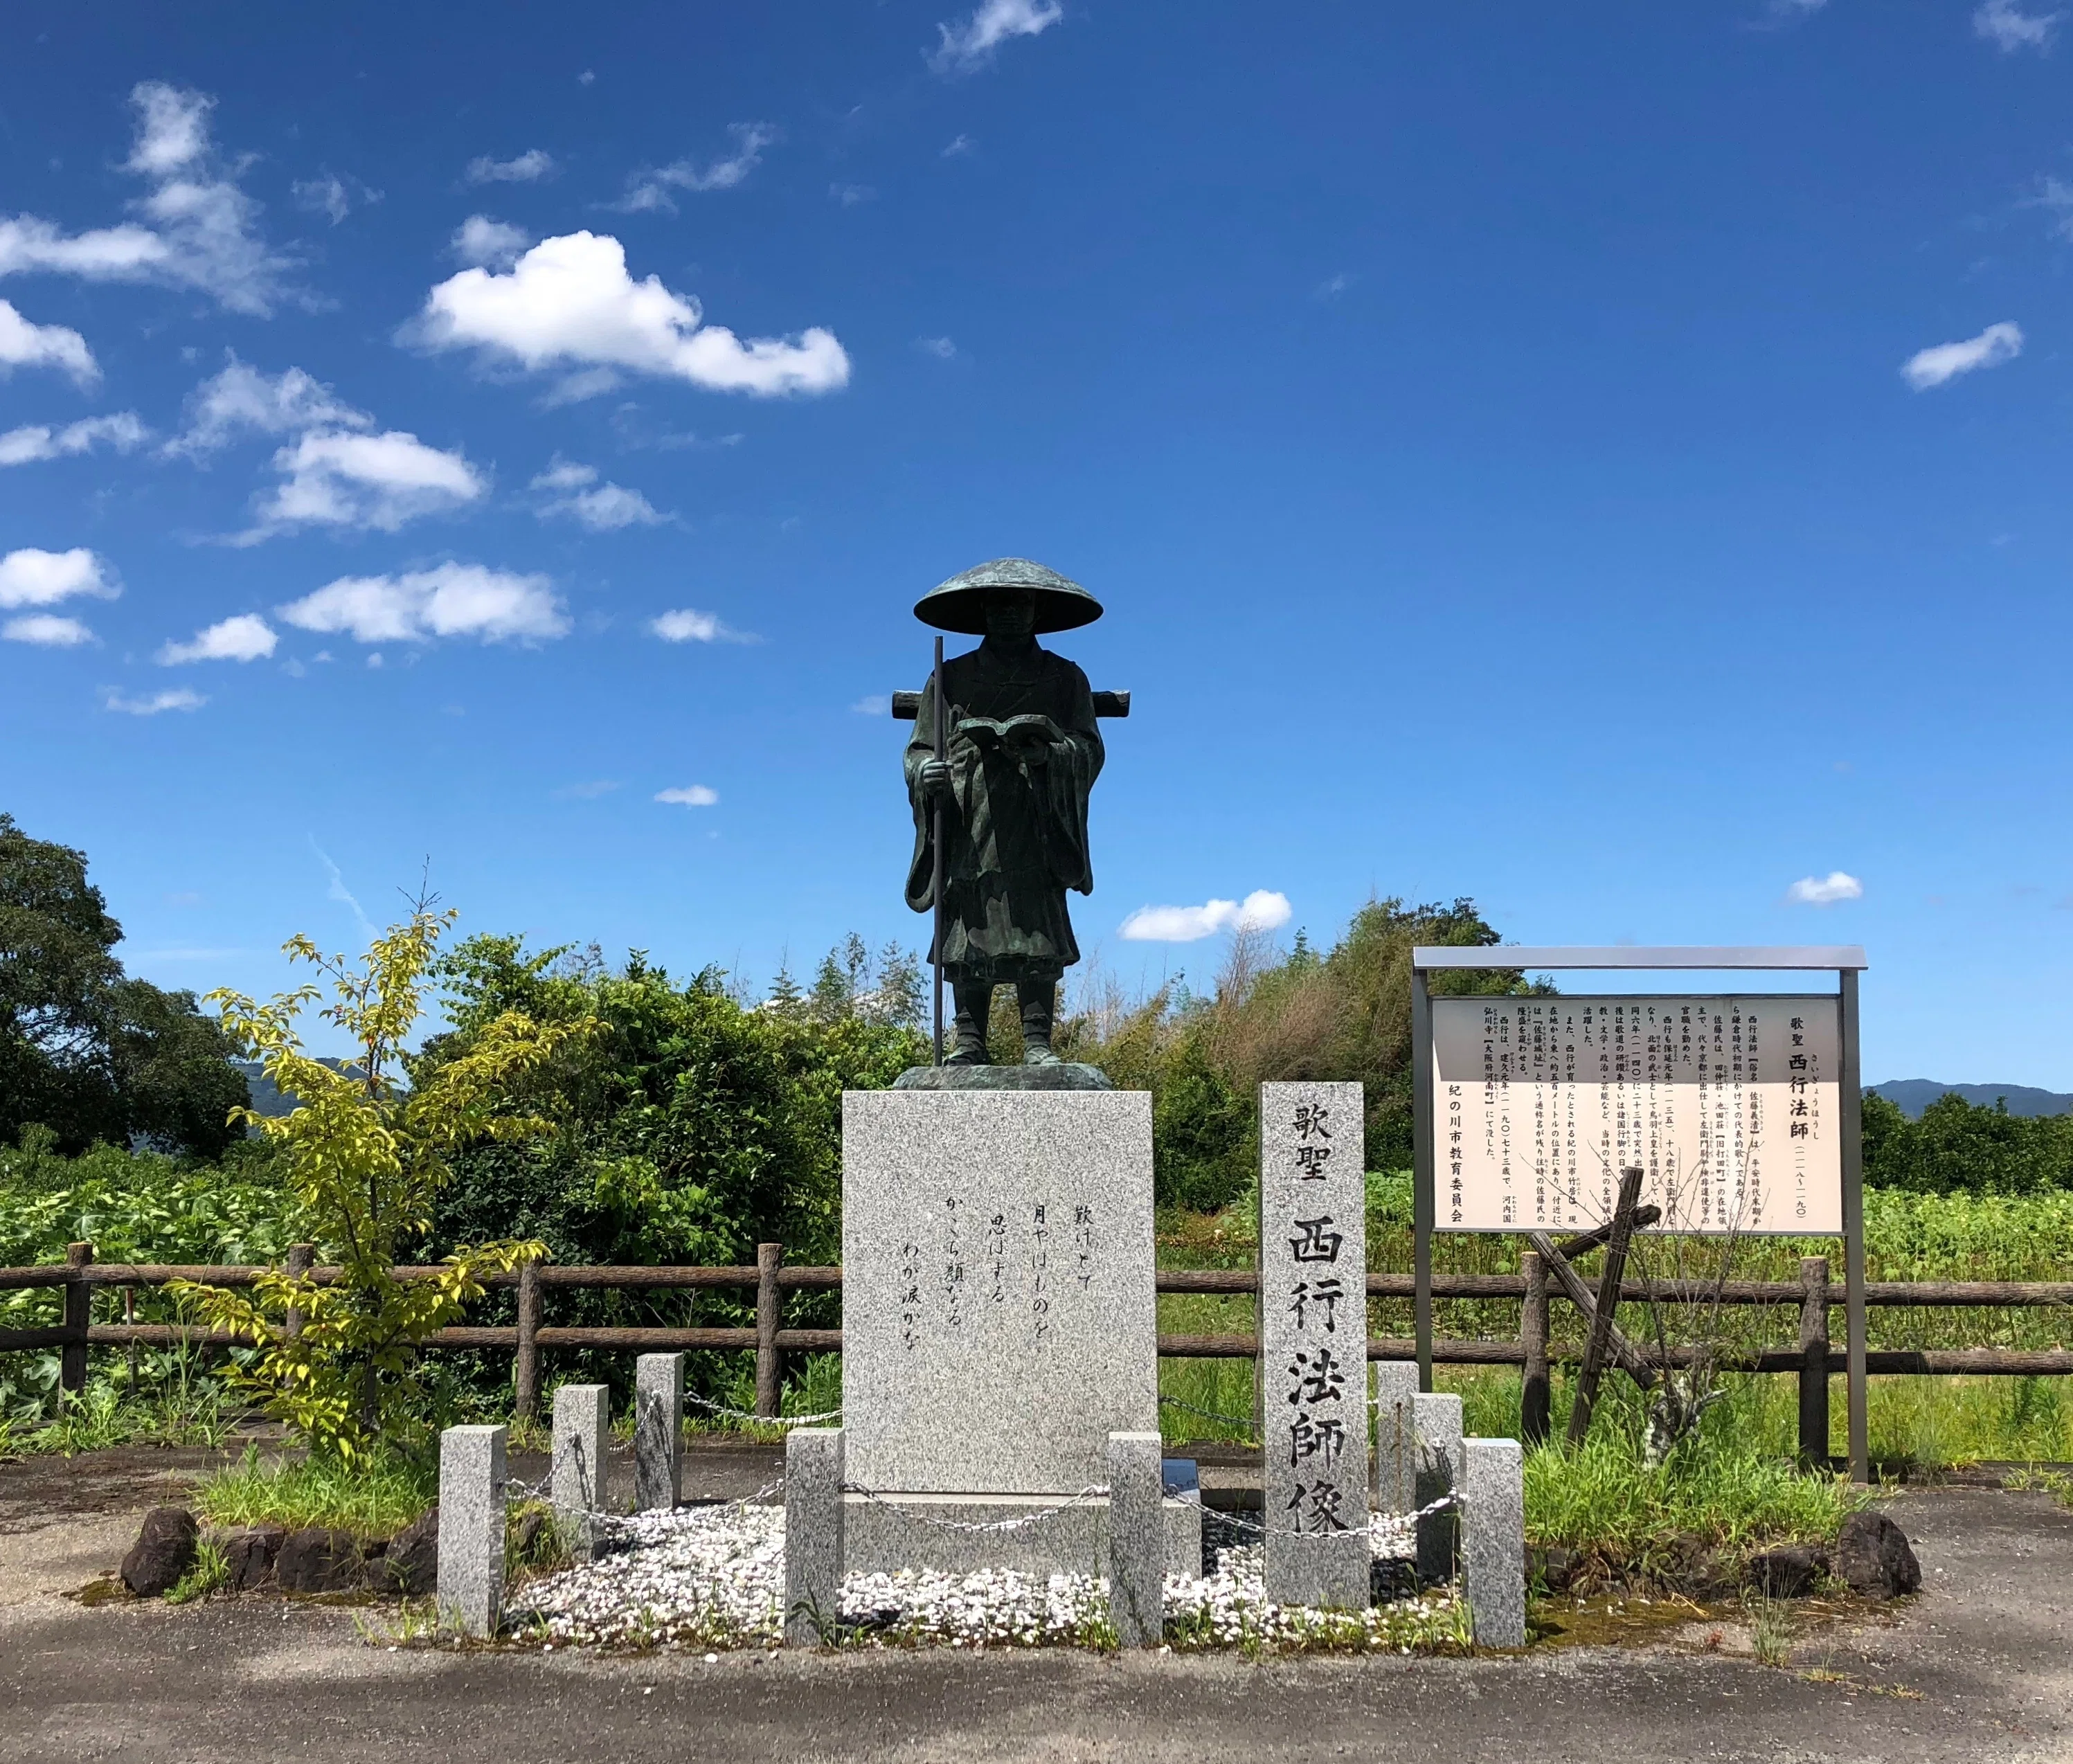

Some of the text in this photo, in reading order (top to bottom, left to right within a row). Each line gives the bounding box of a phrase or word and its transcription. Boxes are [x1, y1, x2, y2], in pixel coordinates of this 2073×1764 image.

[1583, 1006, 1594, 1047] 活躍した。
[1791, 1016, 1804, 1047] 歌聖
[1788, 1053, 1809, 1141] 西行法師
[1811, 1054, 1820, 1140] さいぎょうほうし
[1448, 1084, 1464, 1223] 紀の川市教育委員会
[901, 1241, 922, 1351] わが涙かな
[988, 1215, 1006, 1303] 思はする
[1032, 1204, 1048, 1338] 月やはものを
[1286, 1102, 1350, 1538] 歌聖 西行法師像
